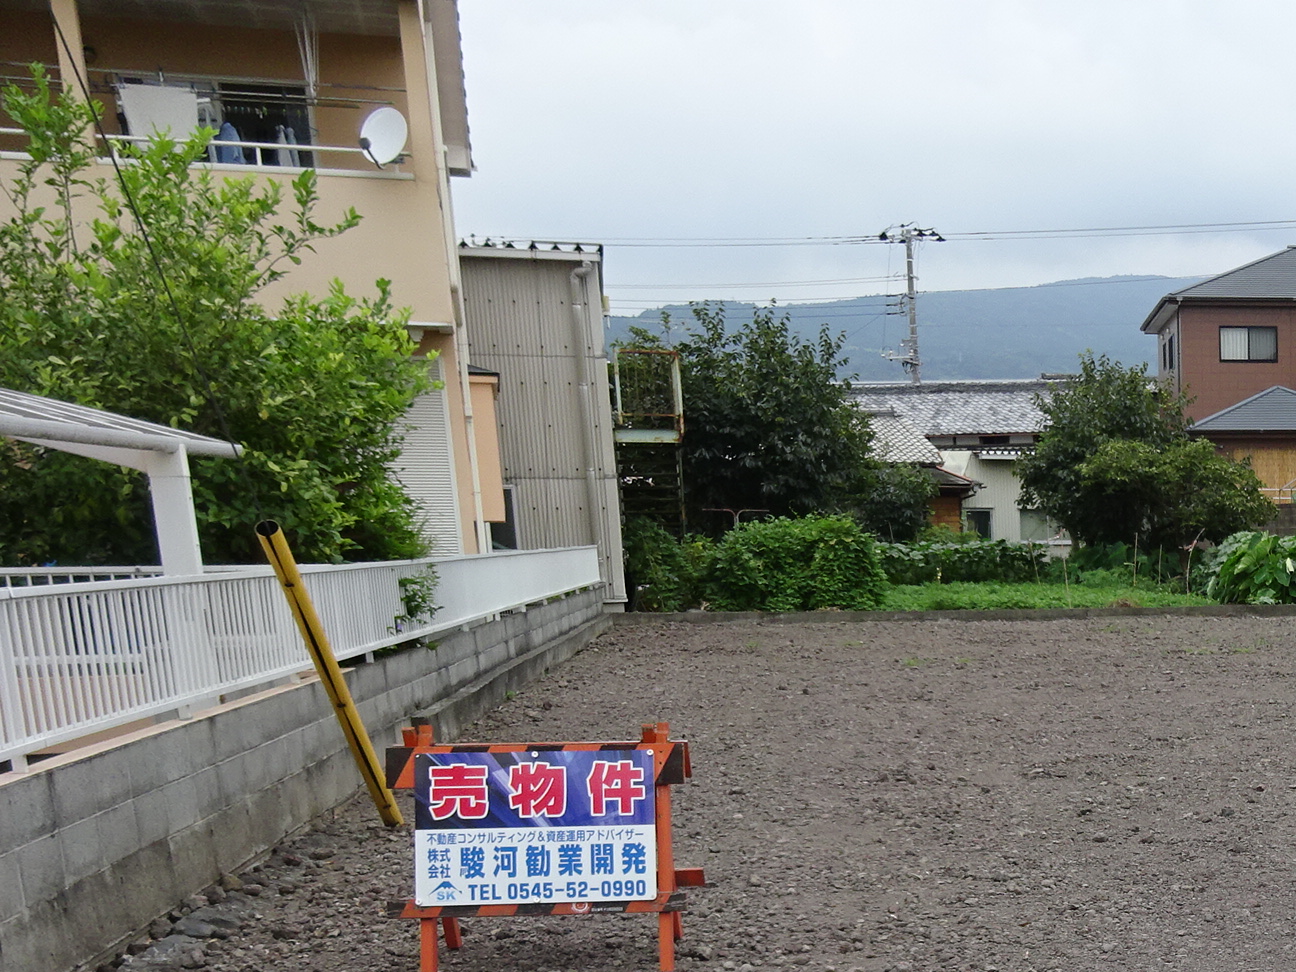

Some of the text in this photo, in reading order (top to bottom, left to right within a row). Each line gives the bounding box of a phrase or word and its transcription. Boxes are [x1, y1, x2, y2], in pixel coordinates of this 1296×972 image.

[429, 760, 645, 820] 売物件
[428, 848, 451, 863] 株式
[460, 842, 647, 879] 駿河勧業開発
[428, 864, 451, 879] 会社
[436, 891, 456, 901] SK
[468, 879, 646, 901] TEL 0545-52-0990
